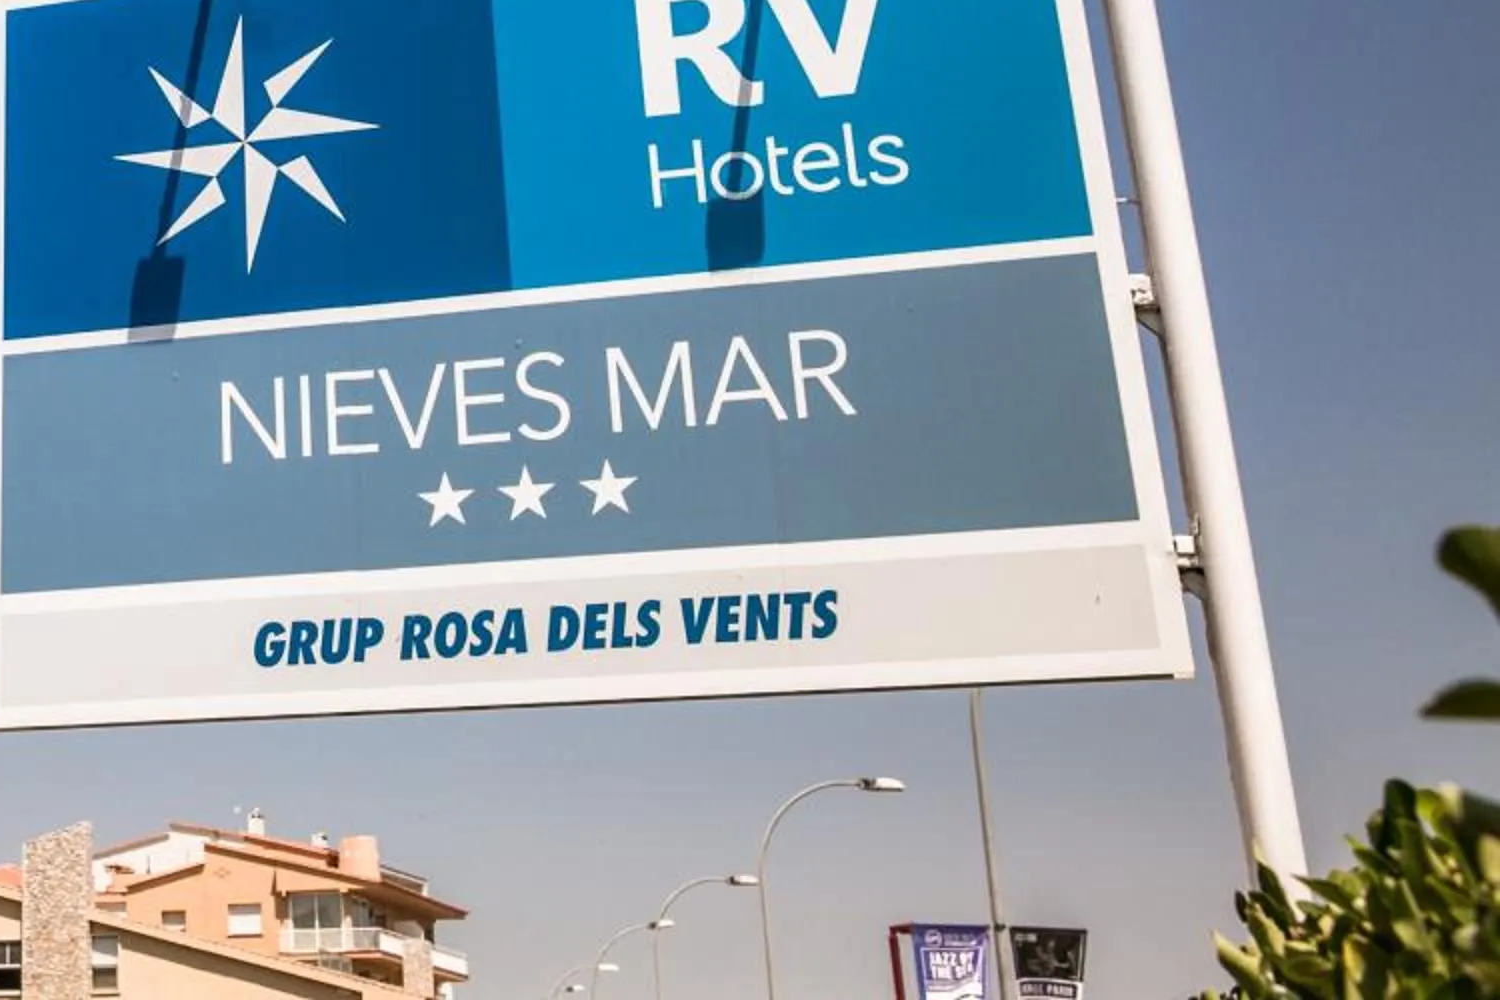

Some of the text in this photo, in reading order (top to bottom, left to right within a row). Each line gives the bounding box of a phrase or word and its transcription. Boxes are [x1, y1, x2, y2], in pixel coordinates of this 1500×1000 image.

[647, 123, 909, 208] Hotels
[221, 330, 857, 464] NIEVES MAR
[254, 590, 838, 667] GRUP ROSA DELS VENTS
